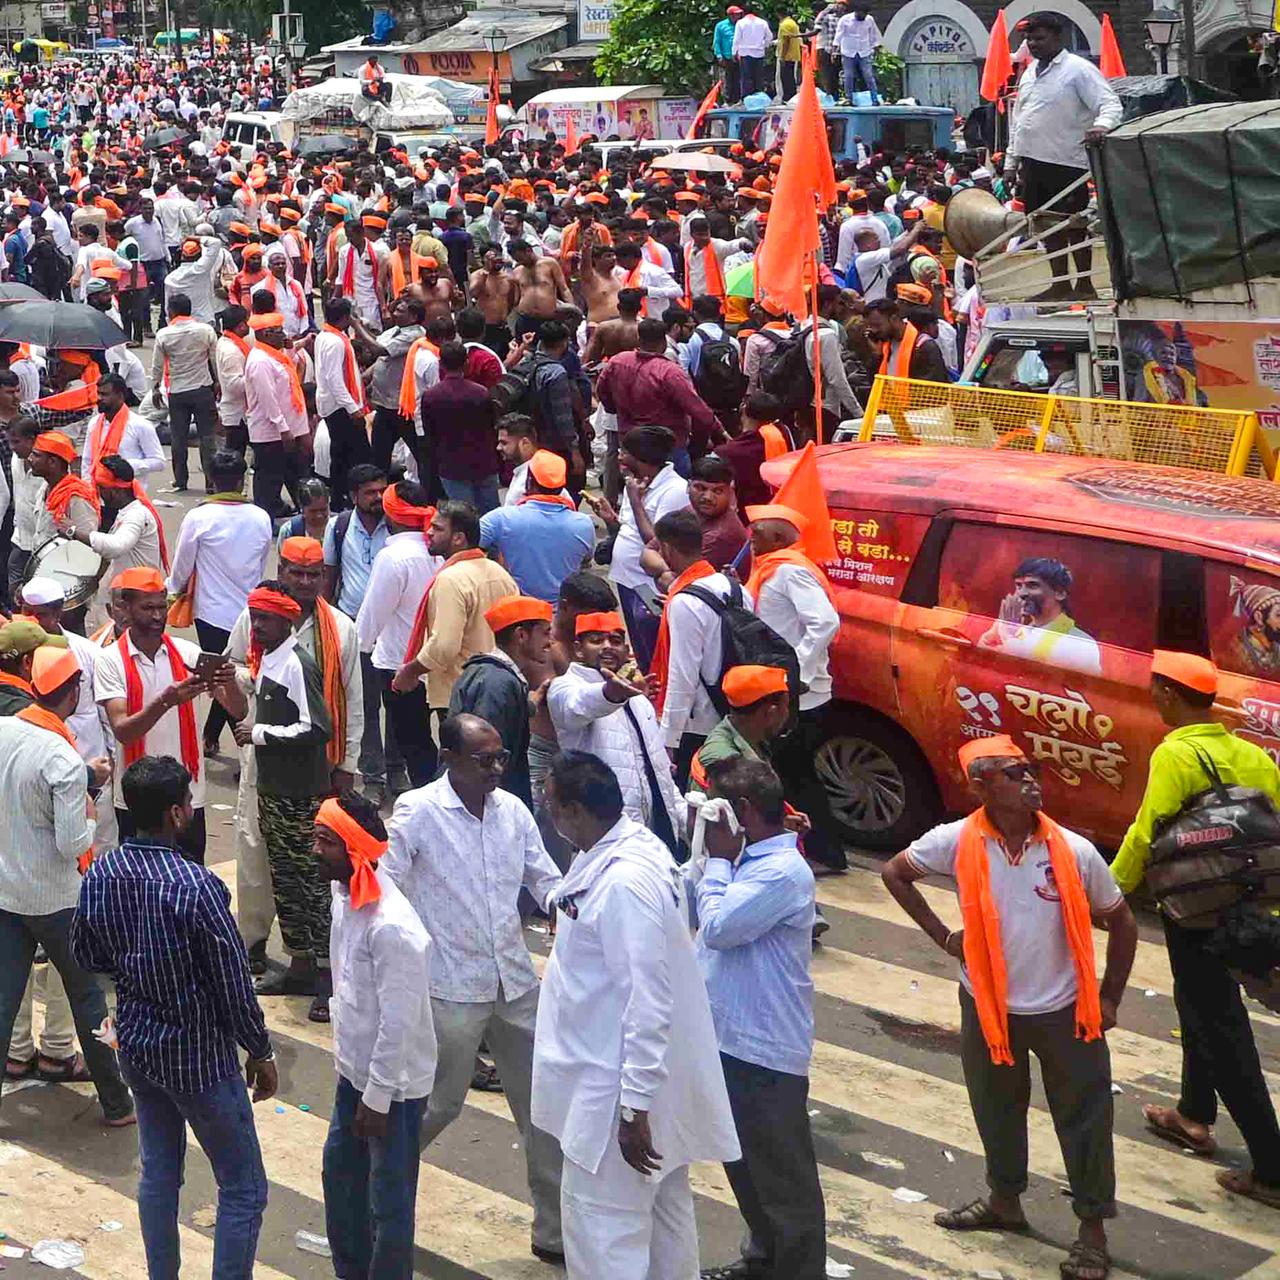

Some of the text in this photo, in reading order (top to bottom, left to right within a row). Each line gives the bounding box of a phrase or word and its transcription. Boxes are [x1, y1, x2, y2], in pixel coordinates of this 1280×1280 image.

[913, 25, 967, 53] CAPITOL
[827, 568, 855, 581] मराठा
[1004, 683, 1097, 740] चलो
[1022, 730, 1130, 791] मुंबई
